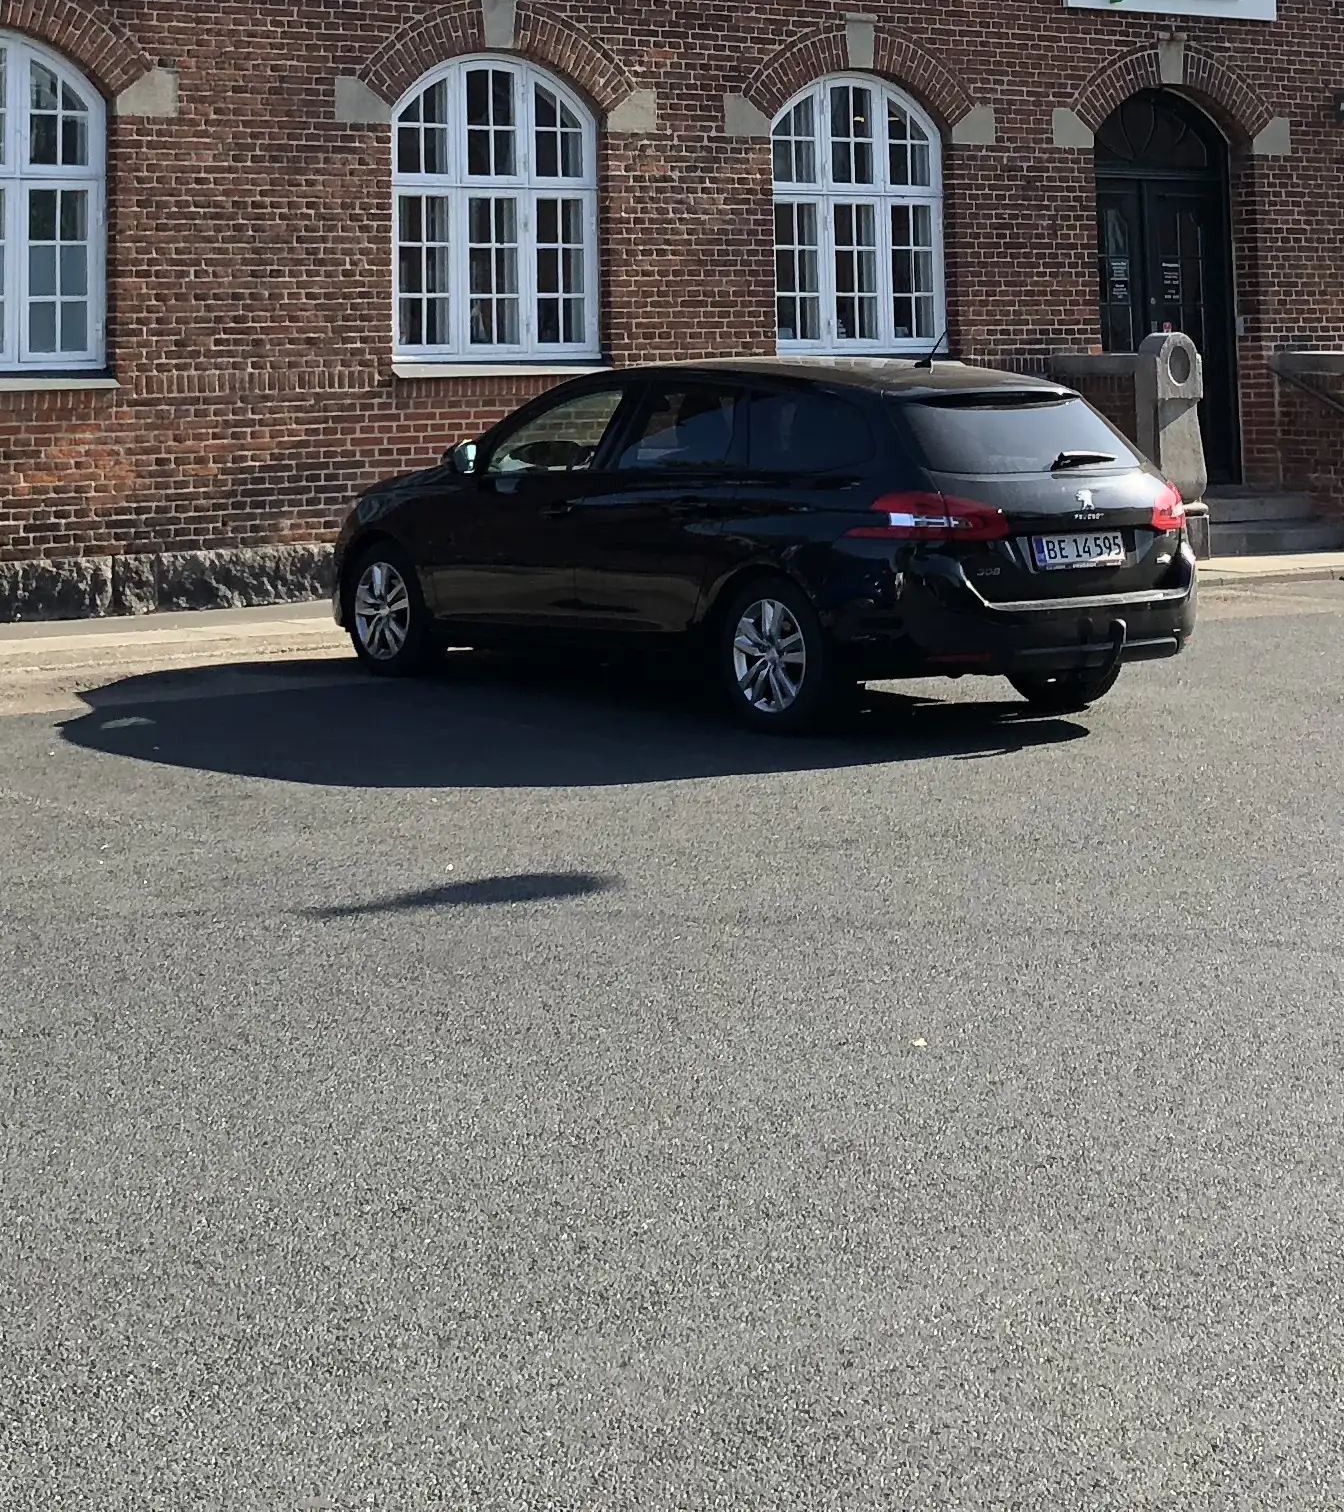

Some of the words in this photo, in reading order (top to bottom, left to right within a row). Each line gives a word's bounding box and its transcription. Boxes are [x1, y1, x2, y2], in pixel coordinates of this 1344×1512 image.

[1045, 539, 1069, 560] BE
[1072, 537, 1092, 558] 14
[1093, 535, 1122, 557] 595
